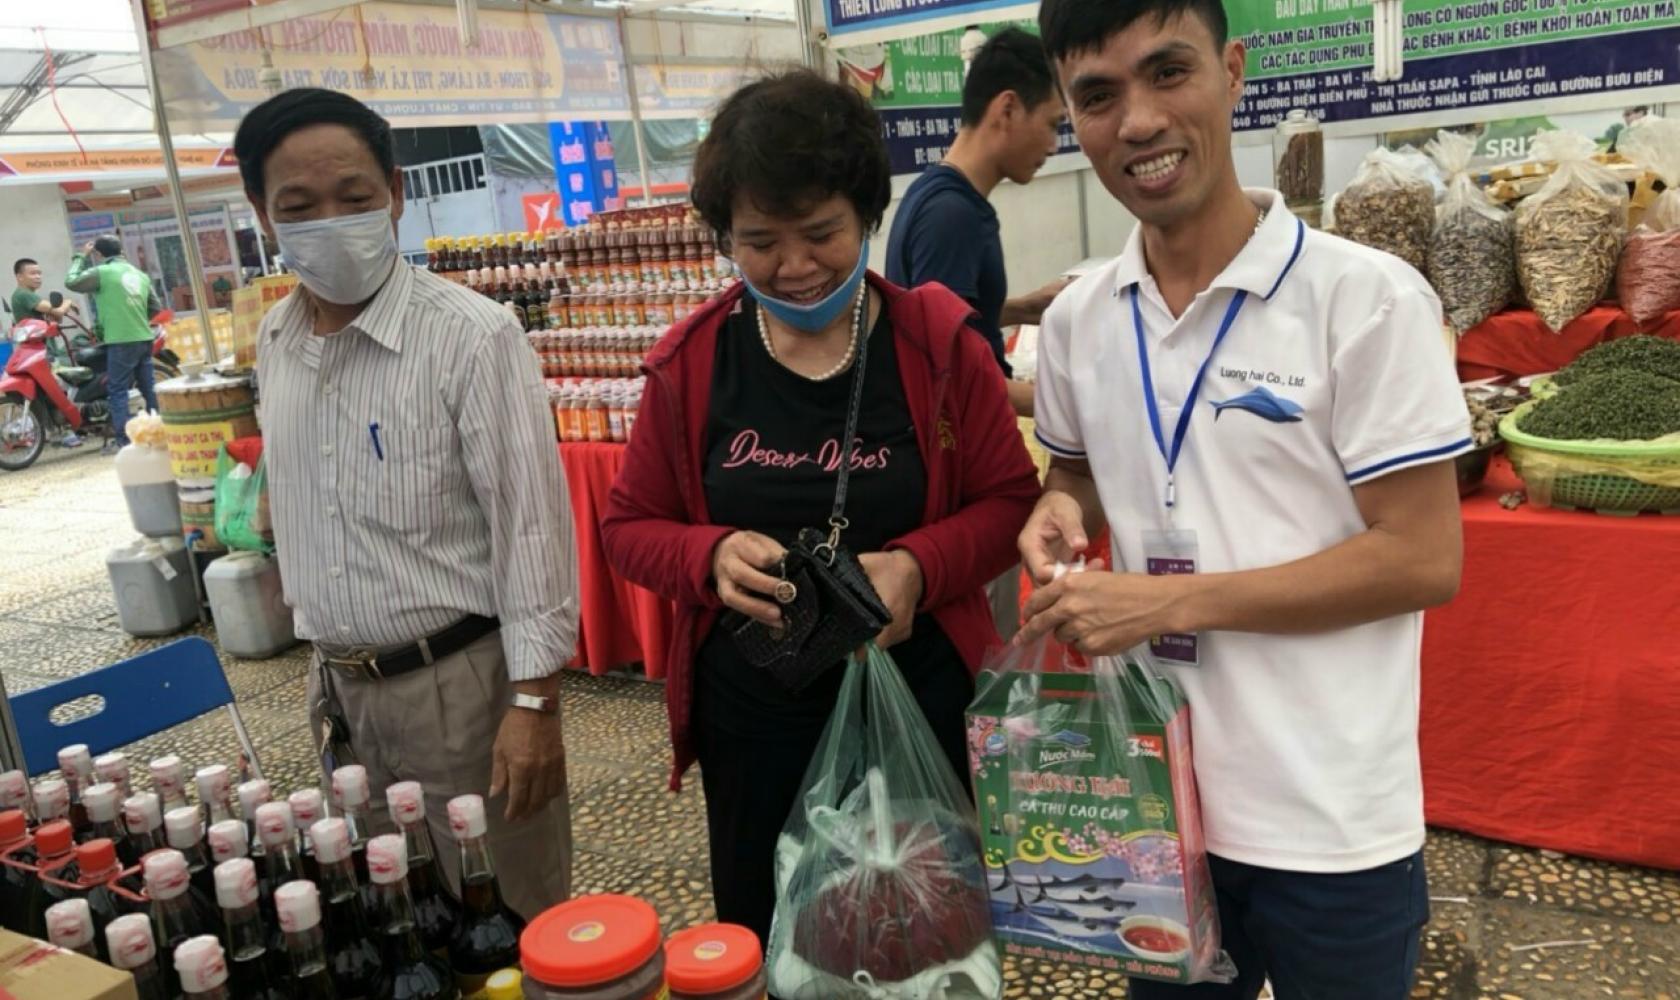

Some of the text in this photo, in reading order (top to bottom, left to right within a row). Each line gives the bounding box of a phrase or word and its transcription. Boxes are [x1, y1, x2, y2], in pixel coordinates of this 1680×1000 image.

[1262, 51, 1282, 69] CÁC
[1285, 46, 1306, 66] TÁC
[1309, 46, 1339, 66] DỤNG
[1343, 42, 1365, 60] PHỤ
[1402, 34, 1418, 52] ÁC
[1423, 30, 1454, 49] BỆNH
[1458, 24, 1491, 43] KHÁC
[1504, 18, 1537, 39] BỆNH
[1541, 9, 1571, 32] KHỎI
[1268, 30, 1293, 47] NAM
[1297, 28, 1315, 42] GIA
[1318, 17, 1360, 39] TRUYỀN
[1248, 100, 1254, 111] 1
[1256, 95, 1291, 111] ĐƯỜNG
[1293, 92, 1317, 107] ĐIỆN
[1319, 88, 1344, 104] BIÊN
[1346, 84, 1368, 101] PHỦ
[1378, 84, 1395, 98] THỊ
[1398, 78, 1427, 95] TRẤN
[1429, 76, 1459, 91] SAPA
[1470, 69, 1497, 86] TỈNH
[1500, 66, 1523, 83] LÀO
[1525, 65, 1546, 79] CAI
[1261, 83, 1268, 95] 5
[1277, 81, 1290, 92] BA
[1293, 77, 1316, 93] TRẠI
[1325, 75, 1339, 87] BA
[1371, 66, 1664, 115] NHÀ THUỐC NHẬN GỬI THUỐC QUA ĐƯỜNG BƯU ĐIỆN
[722, 429, 892, 472] Desert Vbes
[1127, 738, 1140, 758] 3
[1041, 801, 1066, 817] THU
[1069, 804, 1097, 819] CAO
